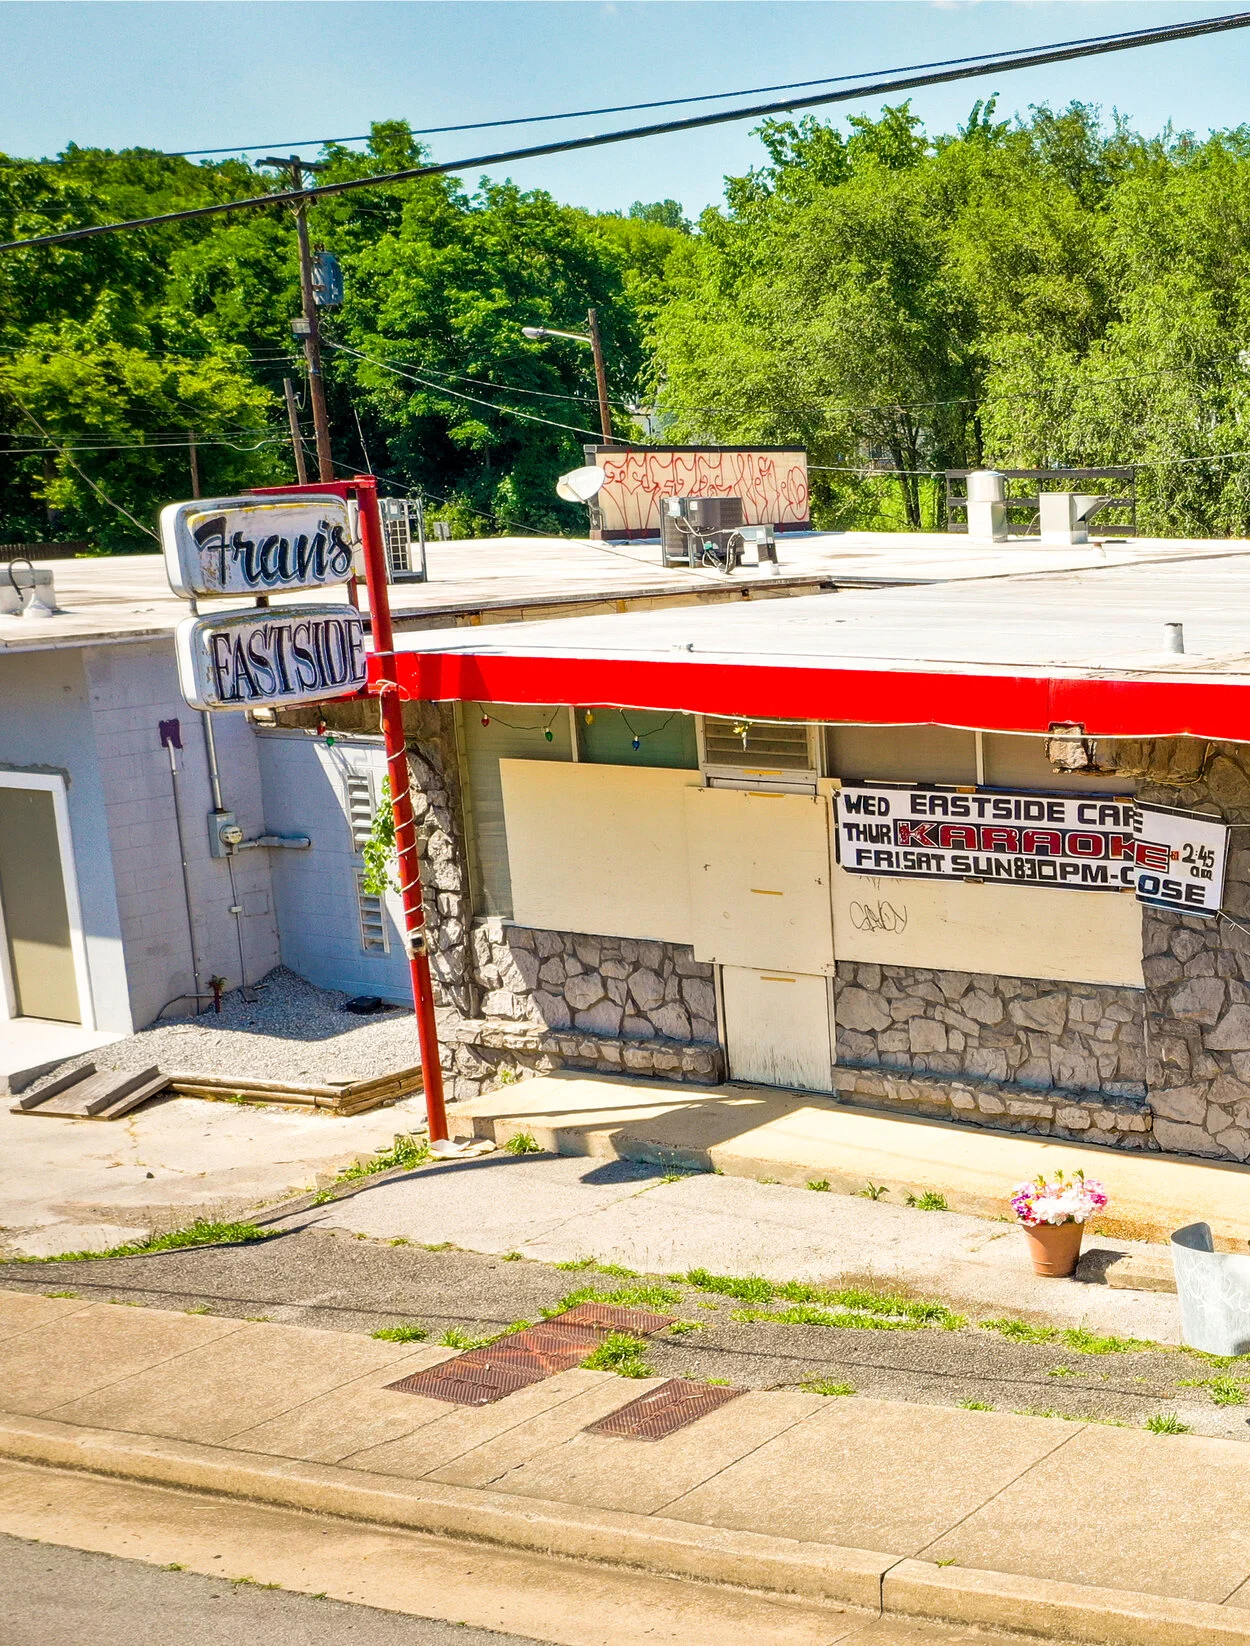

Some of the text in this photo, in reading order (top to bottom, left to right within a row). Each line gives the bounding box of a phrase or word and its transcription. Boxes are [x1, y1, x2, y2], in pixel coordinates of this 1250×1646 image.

[193, 516, 352, 587] Fran's
[211, 619, 367, 701] EASTSIDE
[844, 794, 891, 817] WED
[910, 793, 1066, 823] EASTSIDE
[843, 822, 892, 845] THUR
[1181, 842, 1215, 869] 2:45
